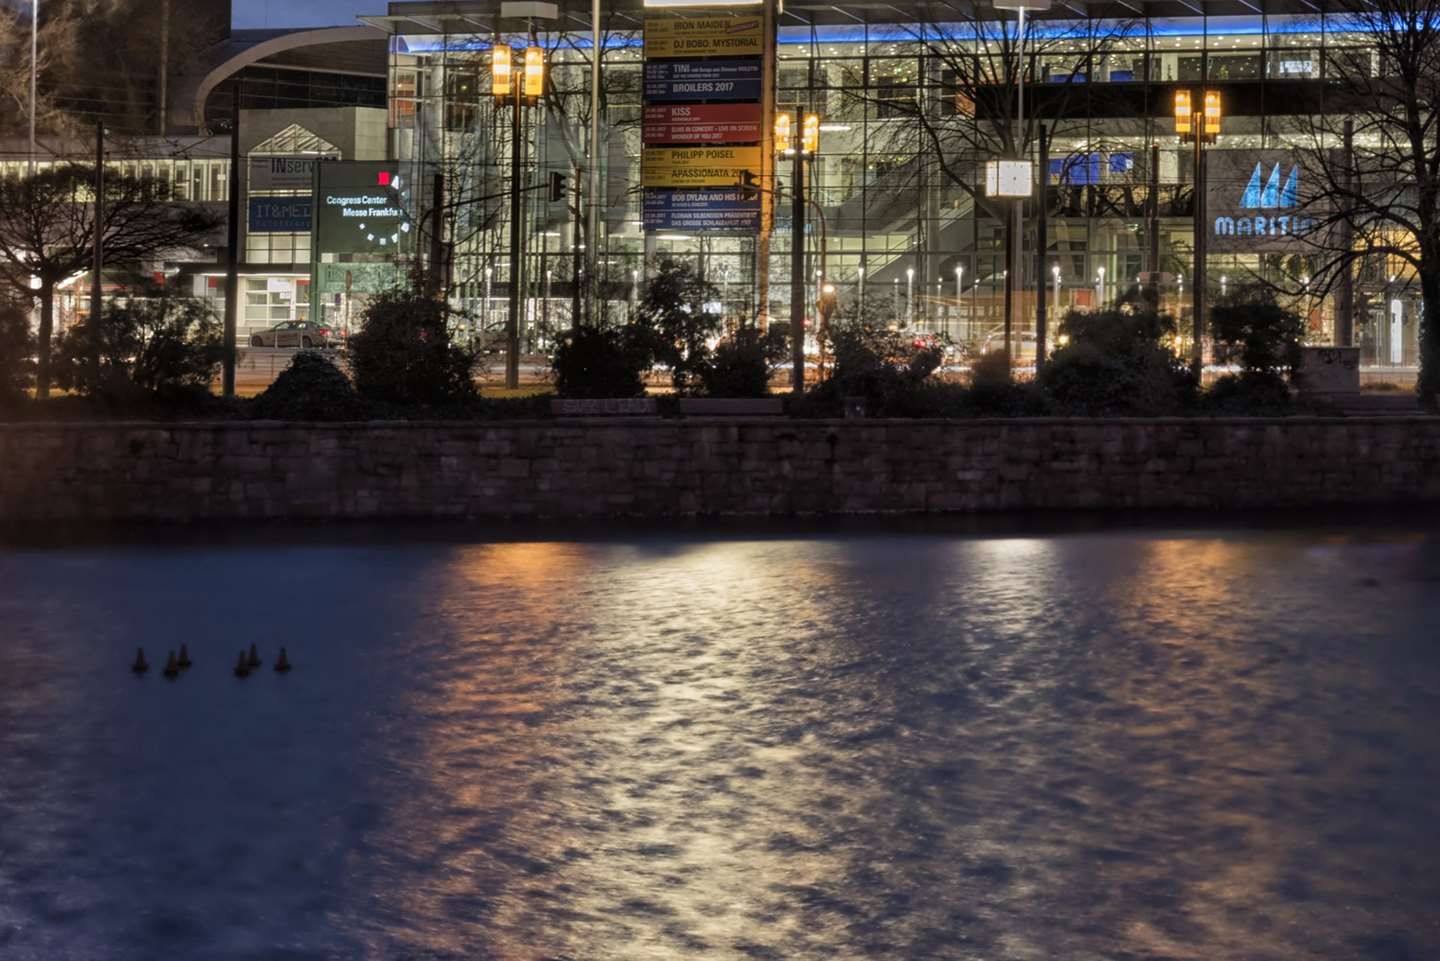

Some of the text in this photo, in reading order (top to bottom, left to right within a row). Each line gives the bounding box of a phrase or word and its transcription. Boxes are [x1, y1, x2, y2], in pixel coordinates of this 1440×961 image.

[673, 21, 695, 31] IRON
[696, 19, 731, 30] MAIDEN
[673, 39, 685, 49] DJ
[712, 38, 759, 48] MYSTORIAL
[673, 64, 690, 73] TINI
[672, 82, 713, 93] BROILERS
[715, 82, 735, 92] 2017
[671, 107, 691, 117] KISS
[671, 150, 704, 159] PHILIPP
[706, 150, 736, 159] POISEL
[671, 168, 729, 178] APASSIONATA
[326, 195, 387, 207] Congress Center
[671, 193, 686, 202] BOB
[686, 193, 708, 202] DYLAN
[708, 193, 723, 201] AND
[724, 193, 736, 201] HIS
[342, 208, 368, 217] Messe
